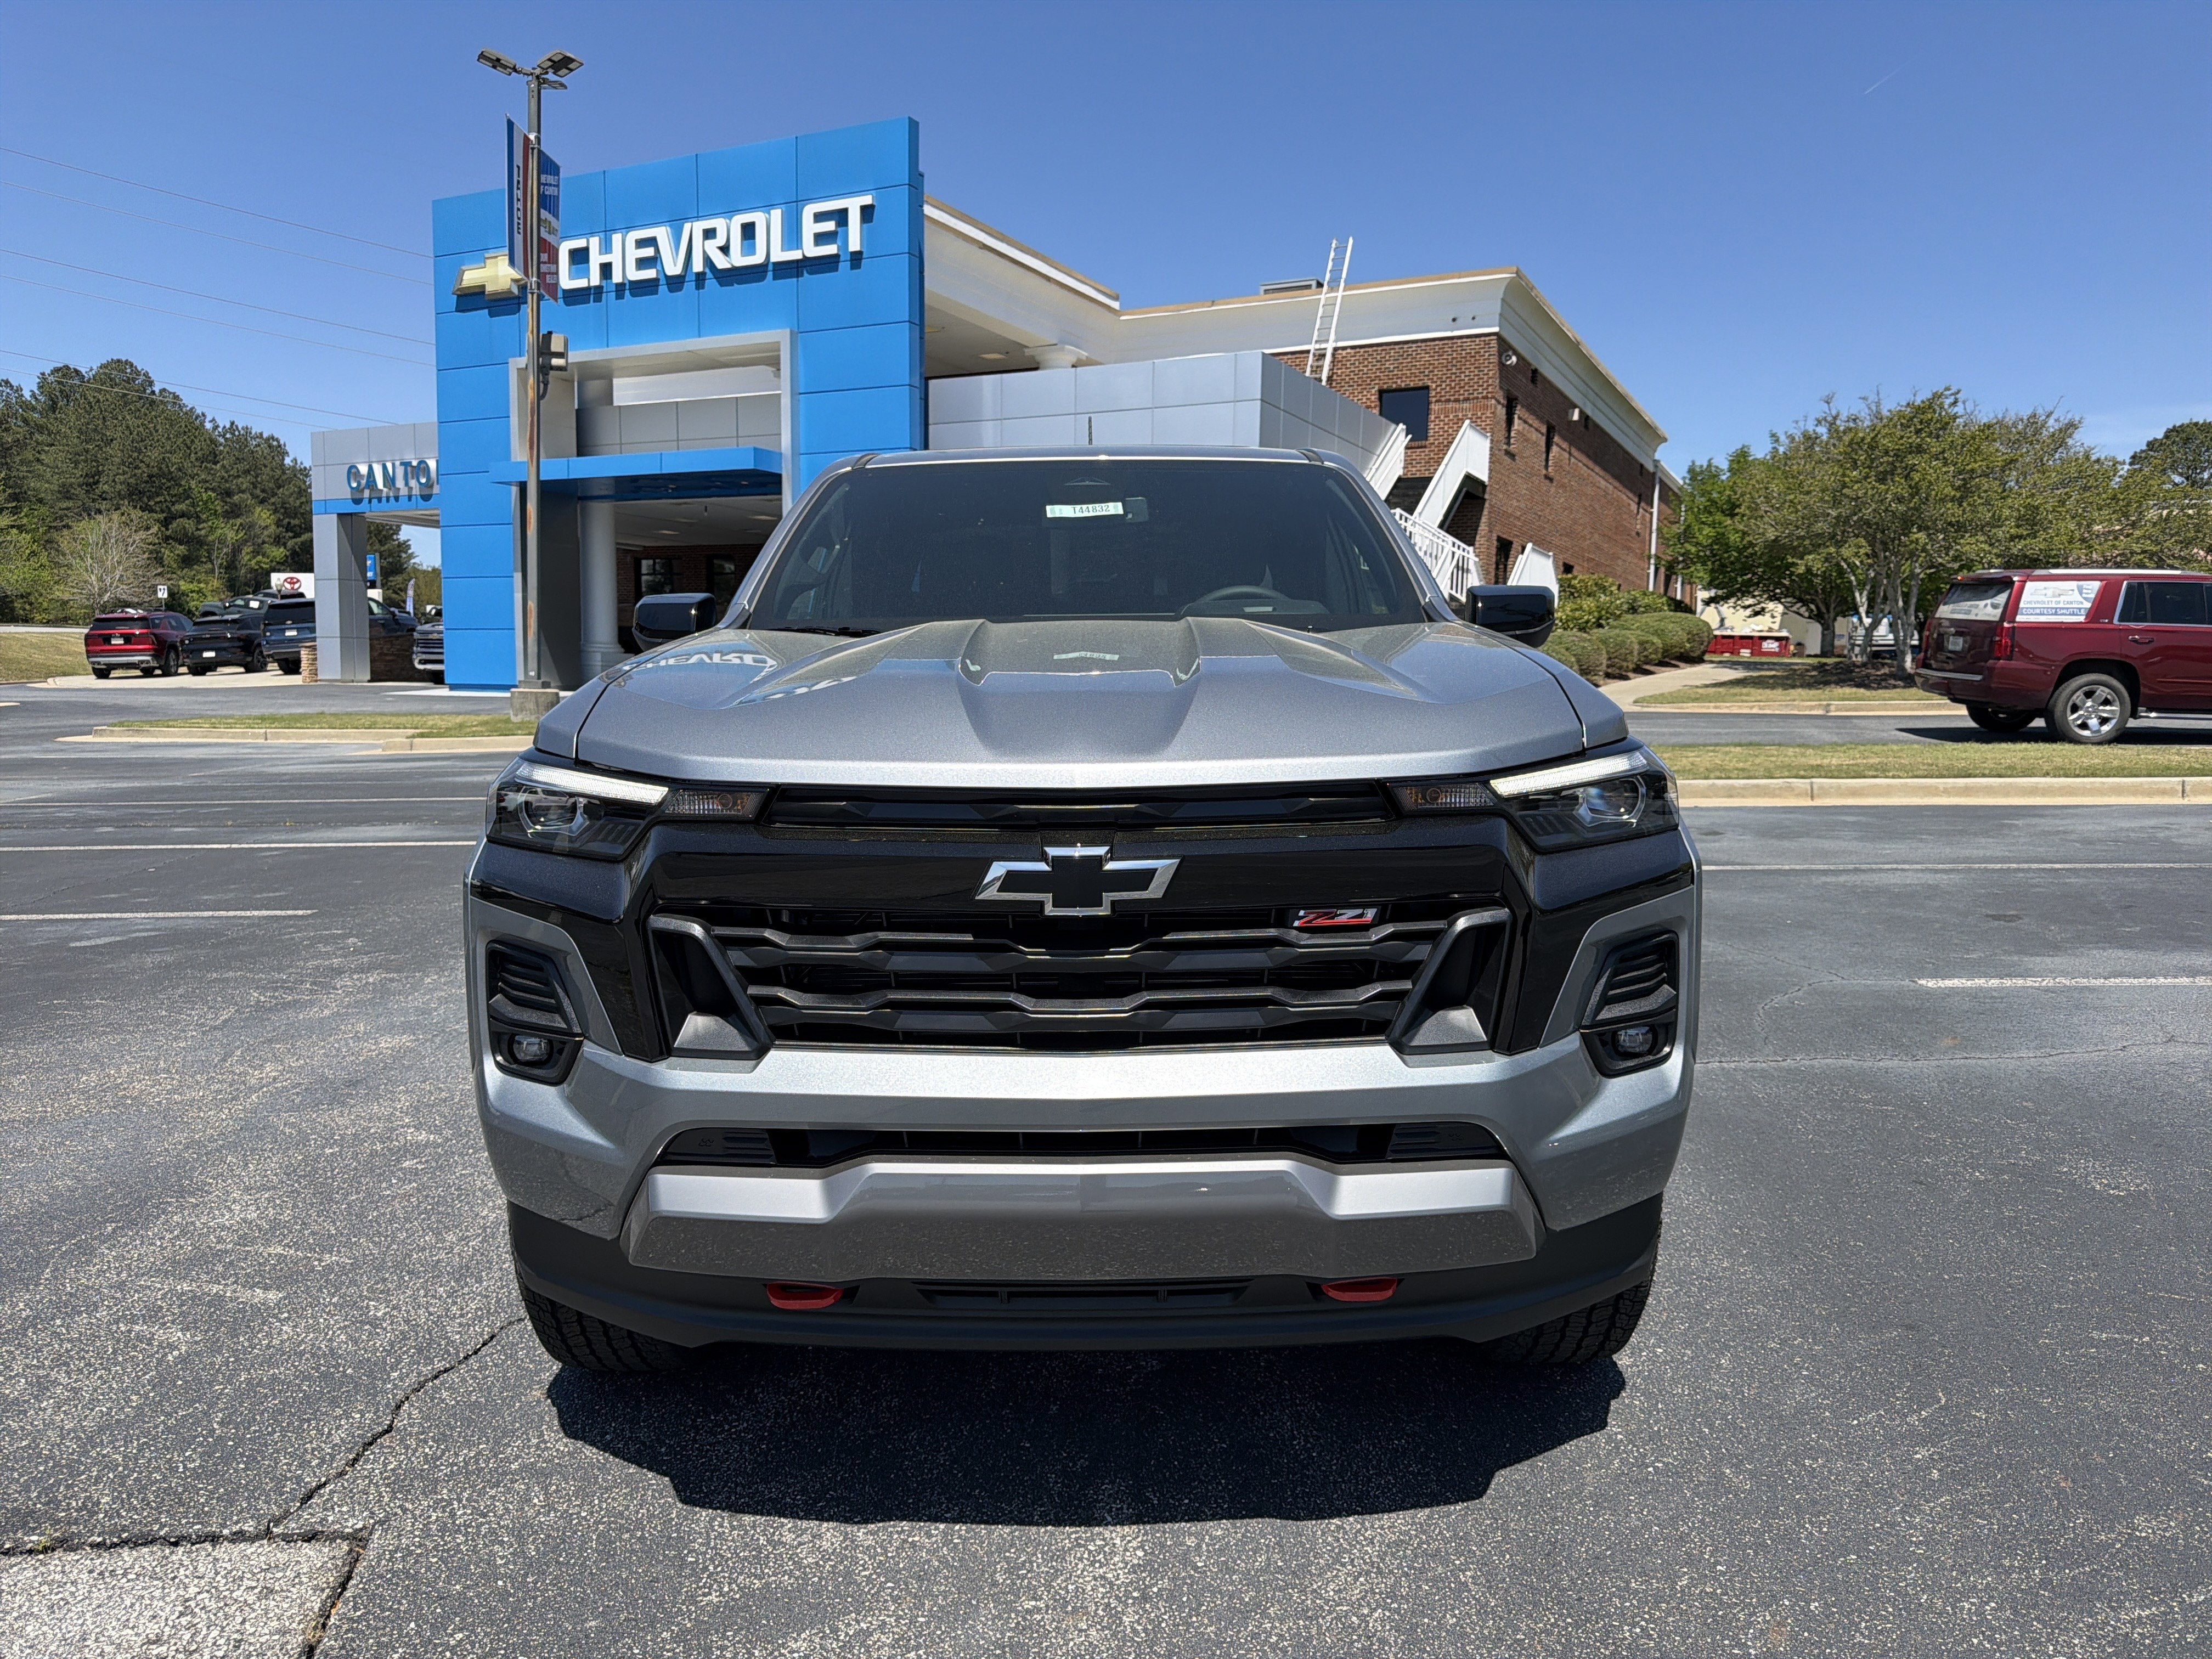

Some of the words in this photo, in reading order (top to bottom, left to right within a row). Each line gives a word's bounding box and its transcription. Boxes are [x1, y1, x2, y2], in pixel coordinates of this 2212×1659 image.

[558, 194, 873, 290] CHEVROLET
[1071, 504, 1110, 515] T44832
[1293, 909, 1378, 927] Z71
